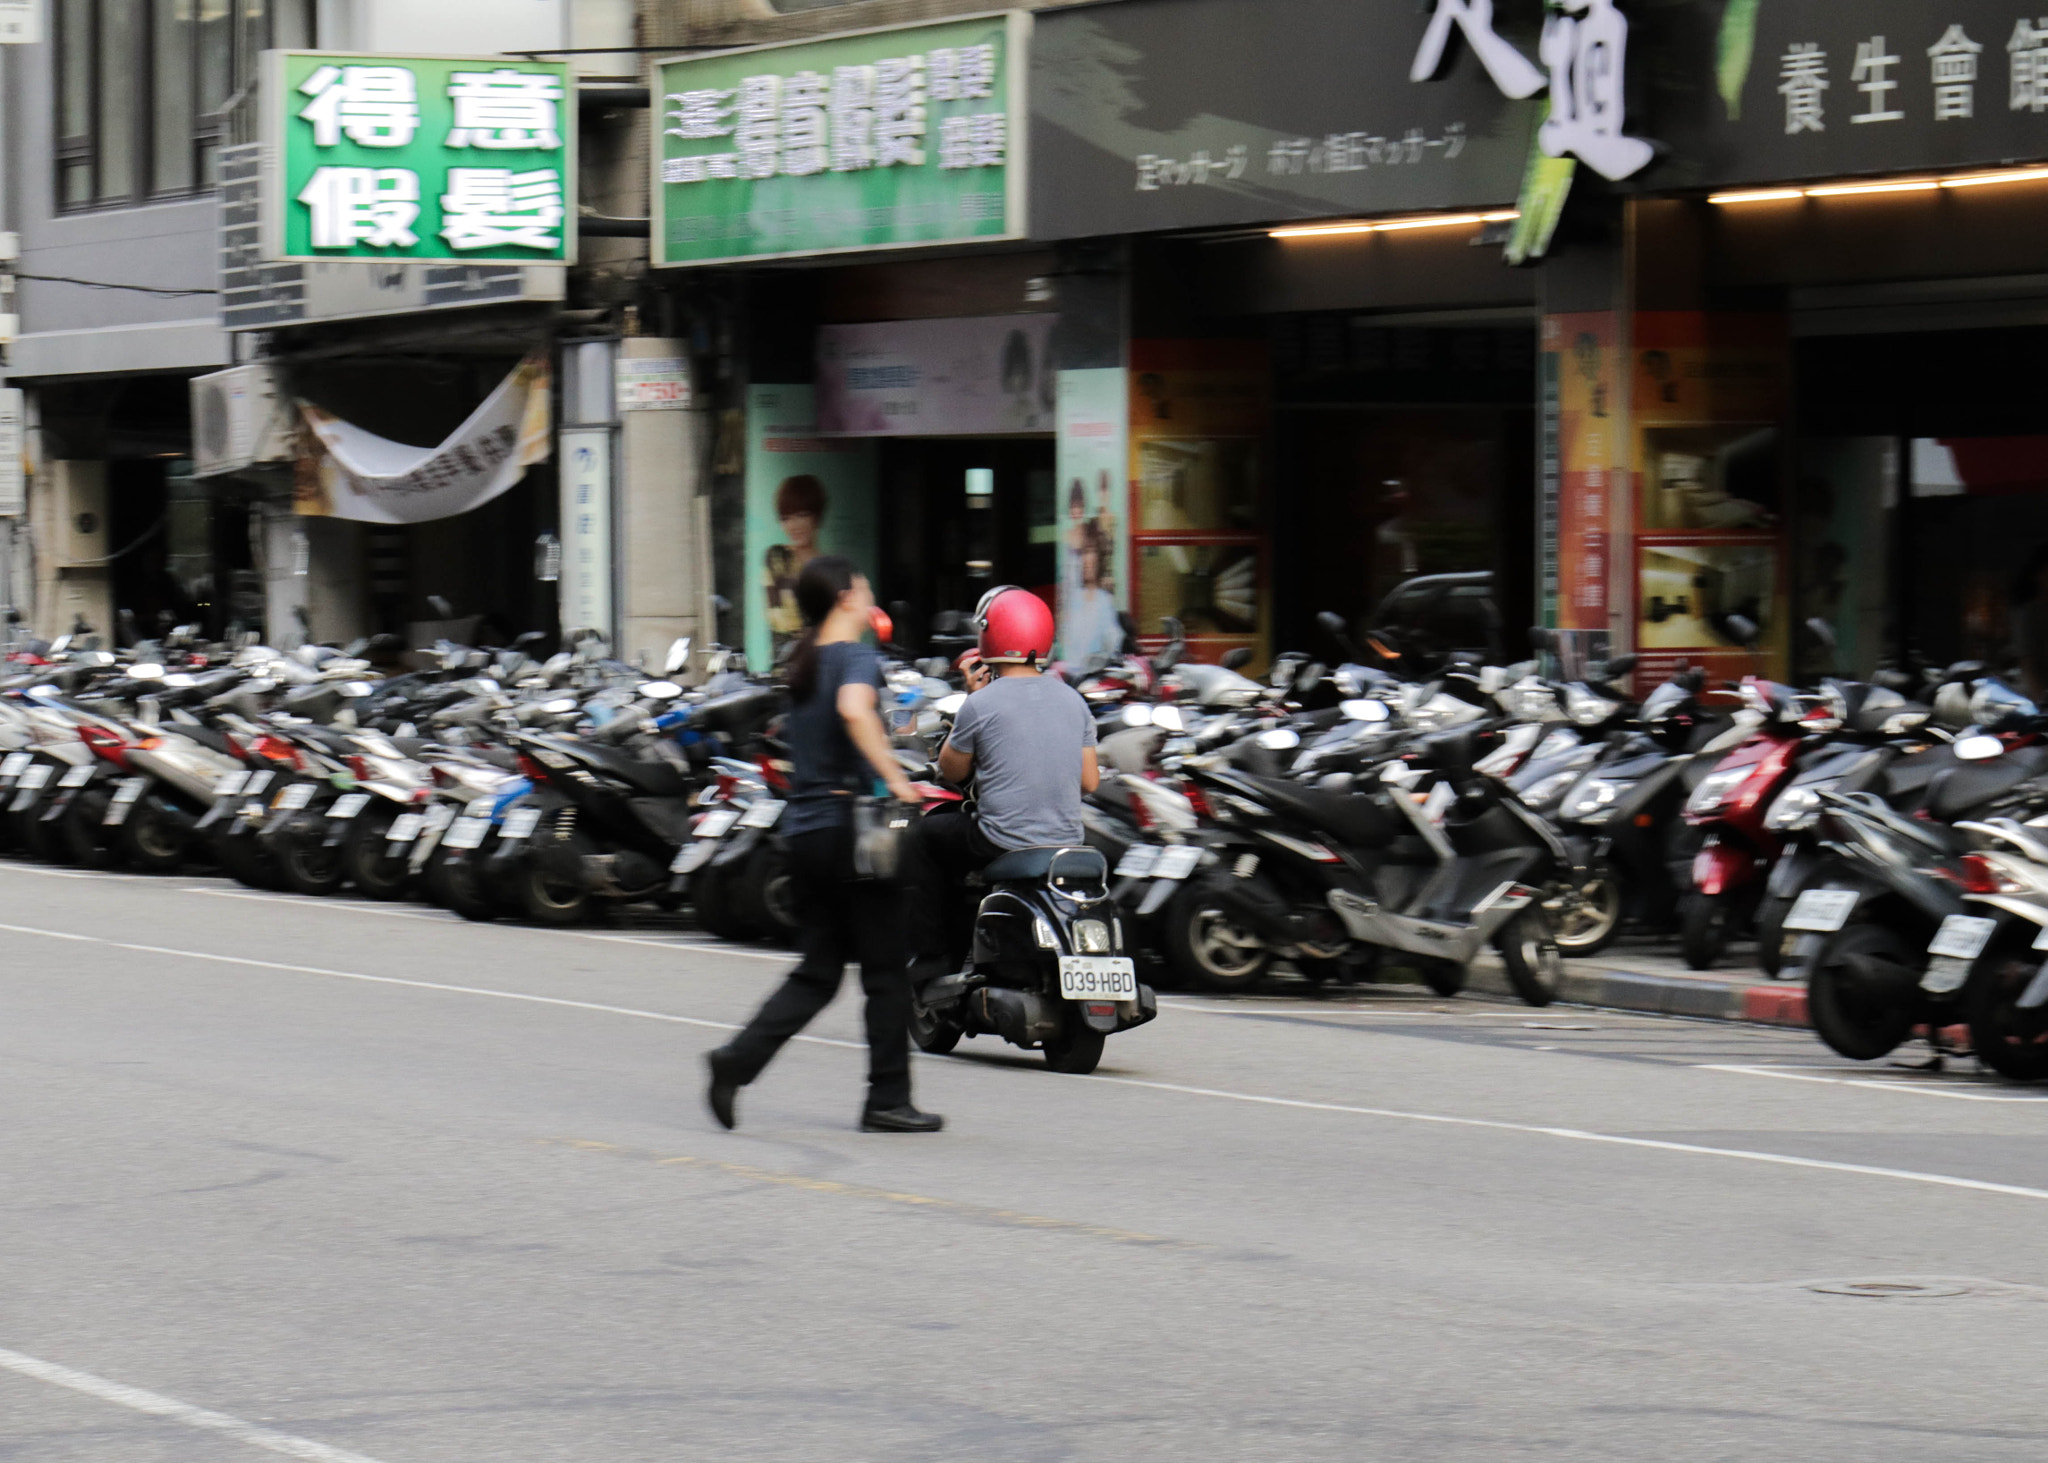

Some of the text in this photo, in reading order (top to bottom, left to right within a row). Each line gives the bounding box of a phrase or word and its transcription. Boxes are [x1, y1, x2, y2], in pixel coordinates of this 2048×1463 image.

[297, 65, 564, 149] 得意
[1777, 17, 2048, 134] 養生會館
[297, 166, 565, 250] 假髮
[1063, 971, 1133, 993] 039-HBD
